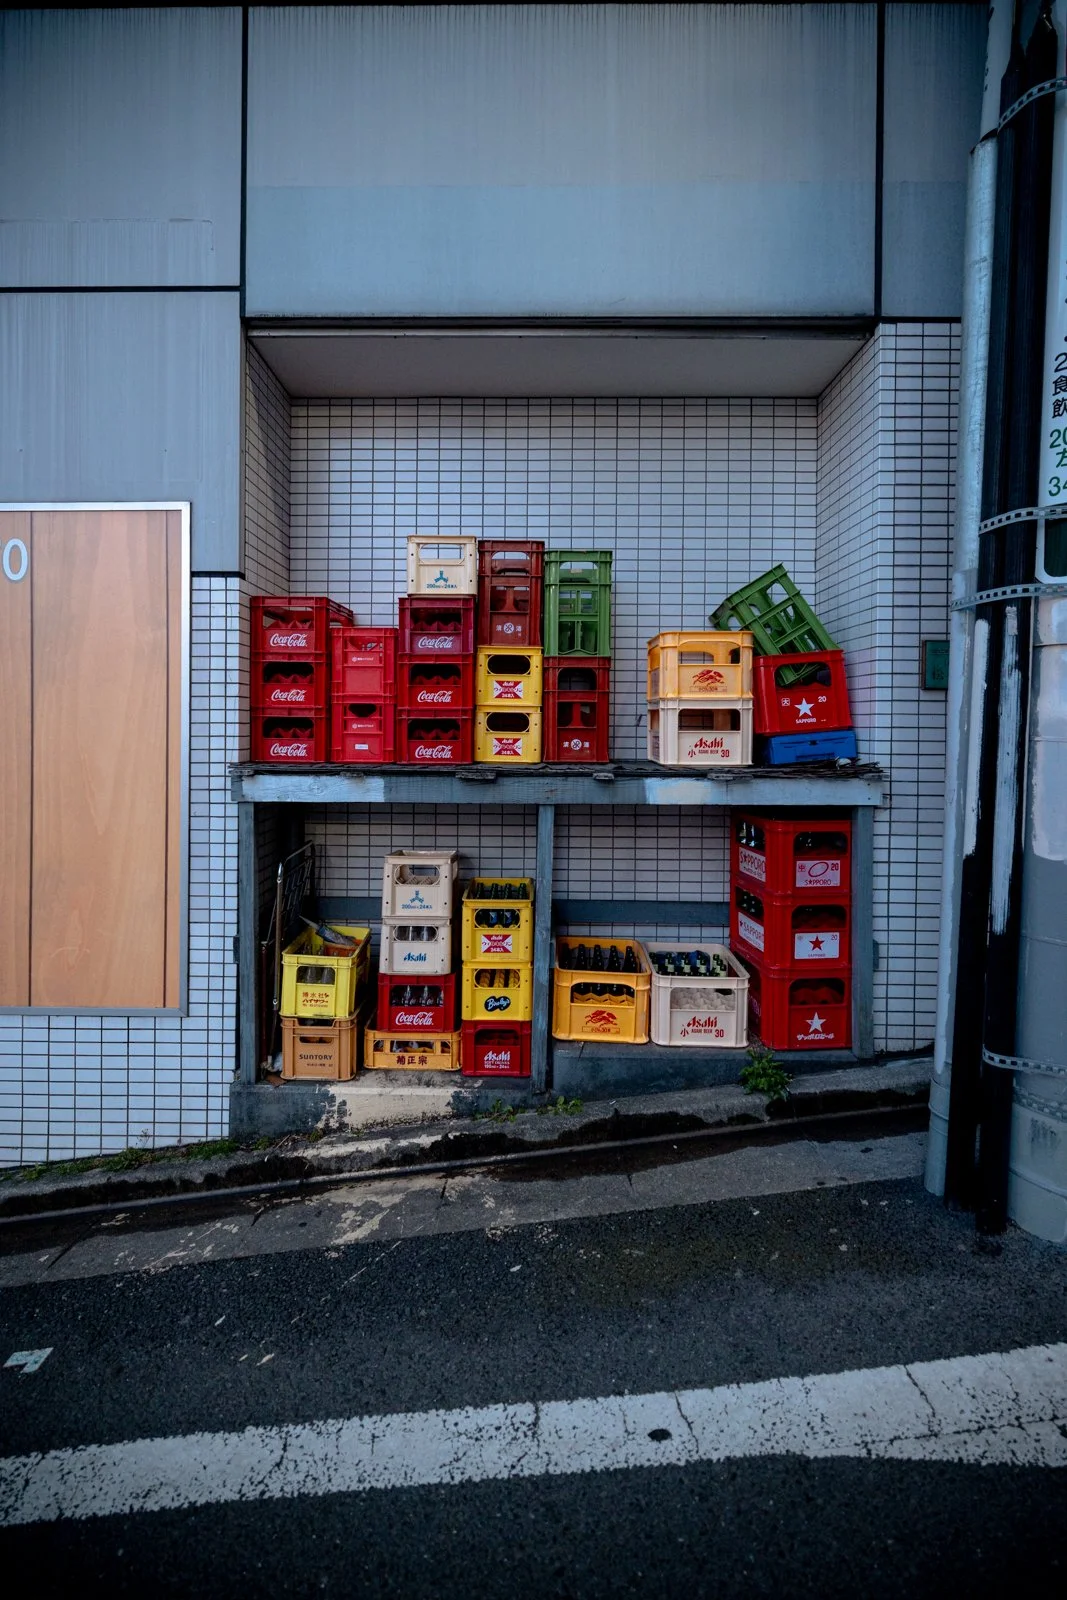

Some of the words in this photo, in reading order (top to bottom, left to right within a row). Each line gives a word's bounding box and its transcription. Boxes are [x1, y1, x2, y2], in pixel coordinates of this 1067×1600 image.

[270, 633, 308, 647] Coca-Cola
[418, 636, 455, 649] Coca-Cola
[271, 689, 307, 702] Coca-Cola
[417, 690, 453, 702] Coca-Cola
[818, 695, 827, 703] 20
[694, 737, 724, 749] Asahi
[270, 743, 308, 757] Coca-Cola
[415, 745, 454, 759] Coca-Cola
[720, 749, 730, 758] 30
[830, 862, 839, 871] 20
[403, 952, 427, 962] Asahi
[395, 1011, 434, 1026] Coca-Cola
[687, 1016, 718, 1028] Asahi
[714, 1028, 724, 1038] 30
[396, 1055, 428, 1066] 菊正宗
[484, 1050, 511, 1061] Asahi
